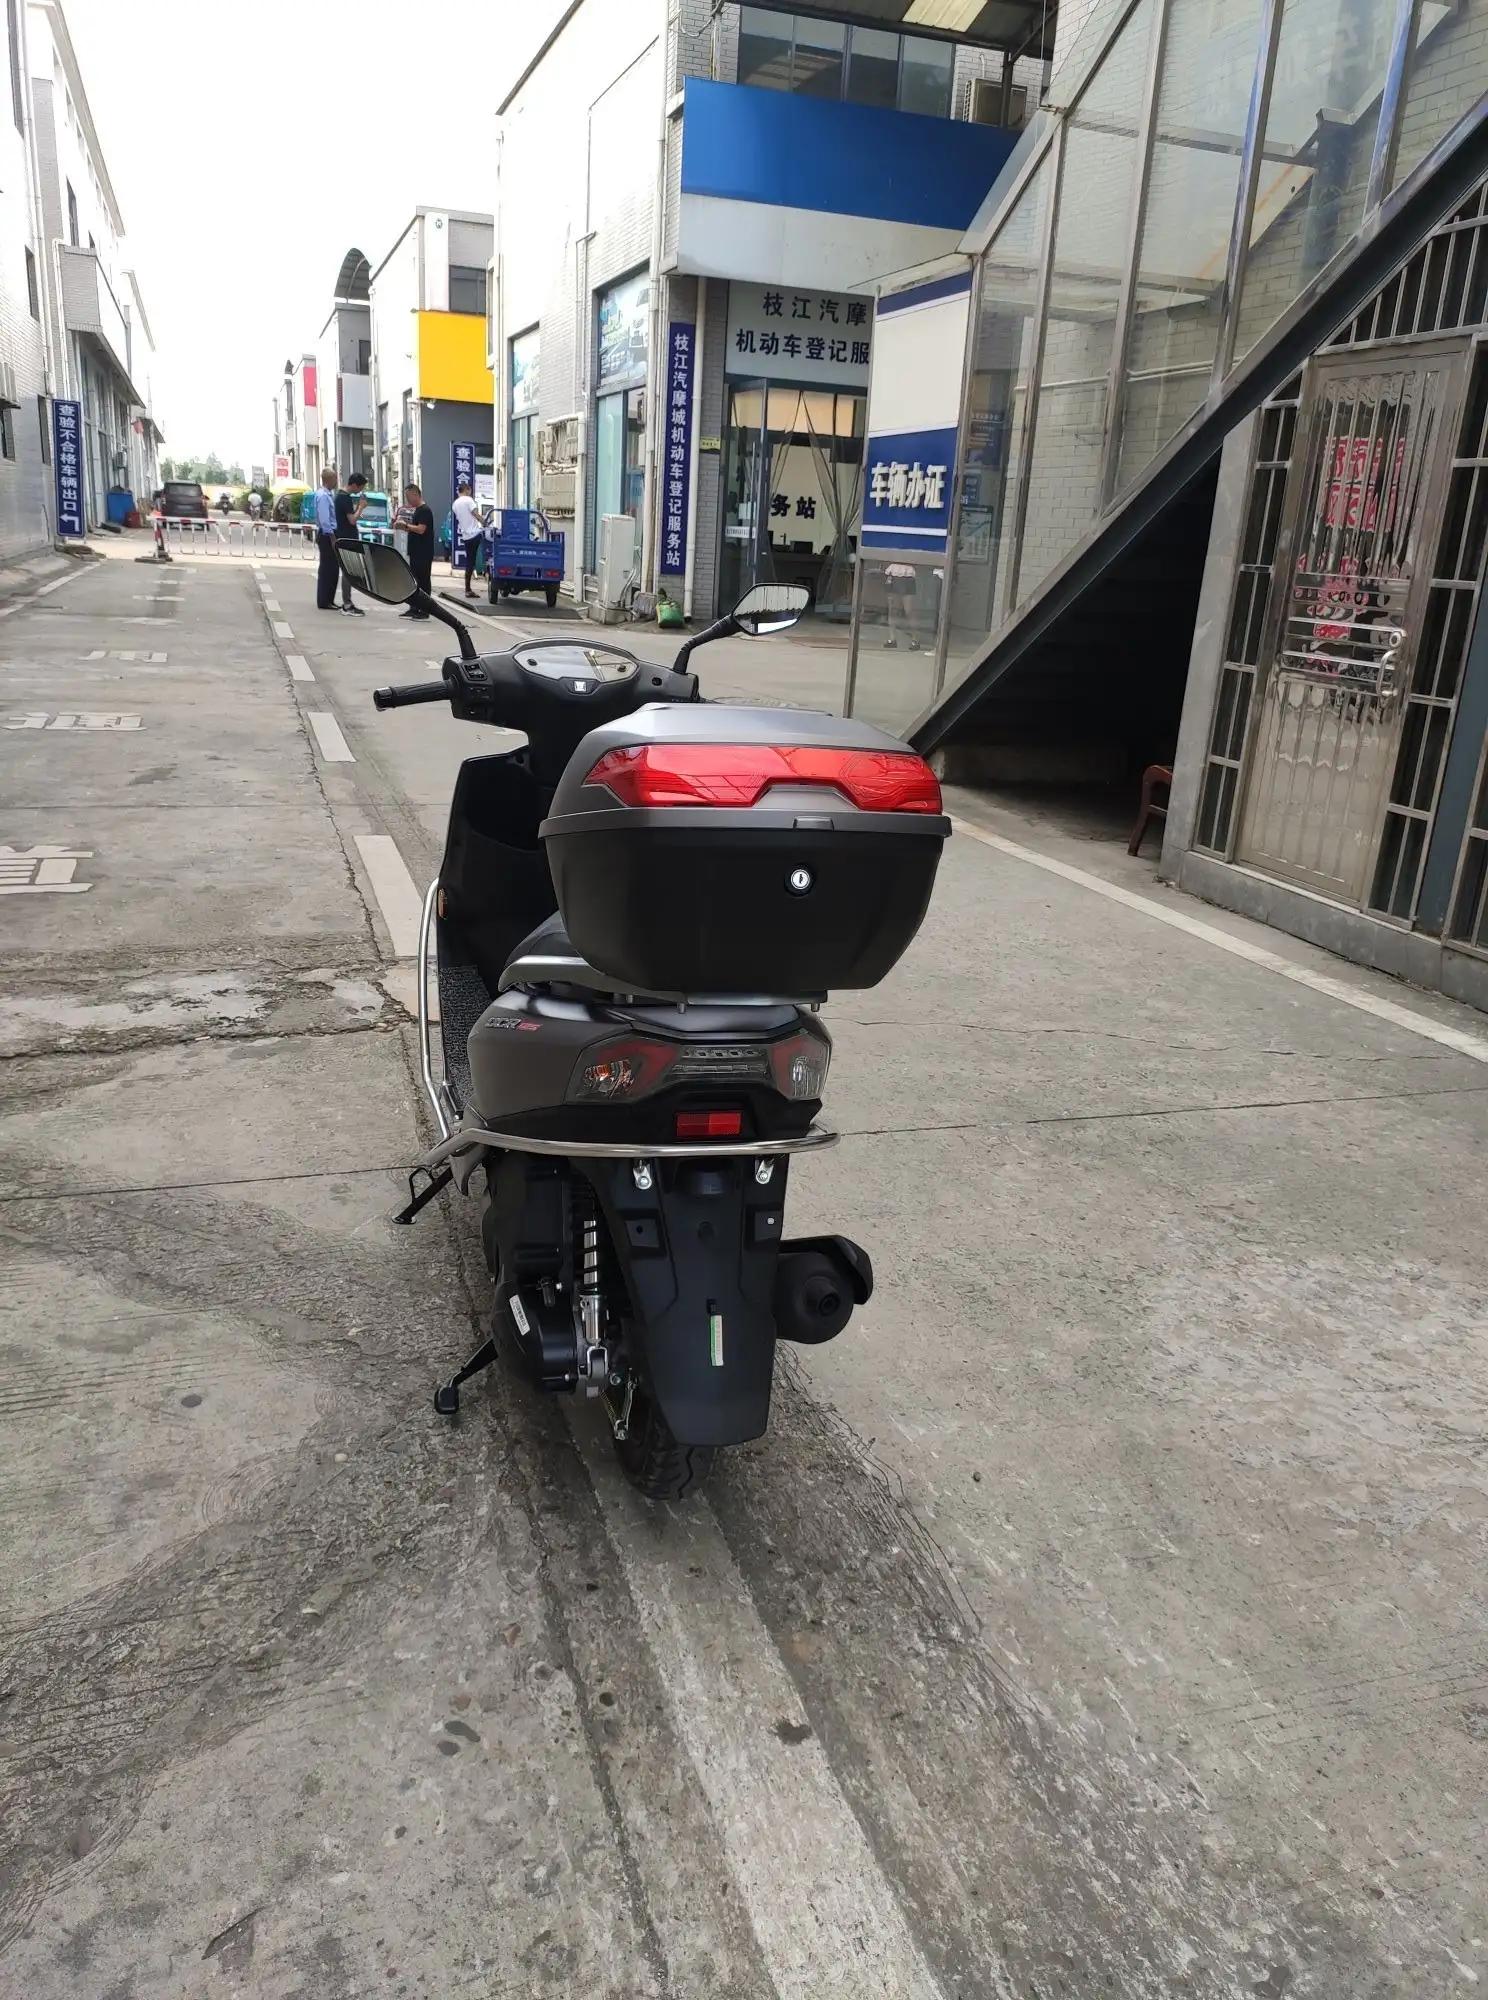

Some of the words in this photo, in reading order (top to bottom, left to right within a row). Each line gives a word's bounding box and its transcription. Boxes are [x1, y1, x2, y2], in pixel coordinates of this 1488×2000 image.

[763, 291, 867, 326] 枝江汽摩
[735, 328, 870, 365] 机动车登记服
[58, 404, 78, 511] 查验不合格车辆出口
[666, 333, 689, 567] 枝江汽摩城机动车登记服务站
[870, 461, 947, 509] 车辆办证
[770, 494, 816, 519] 务站
